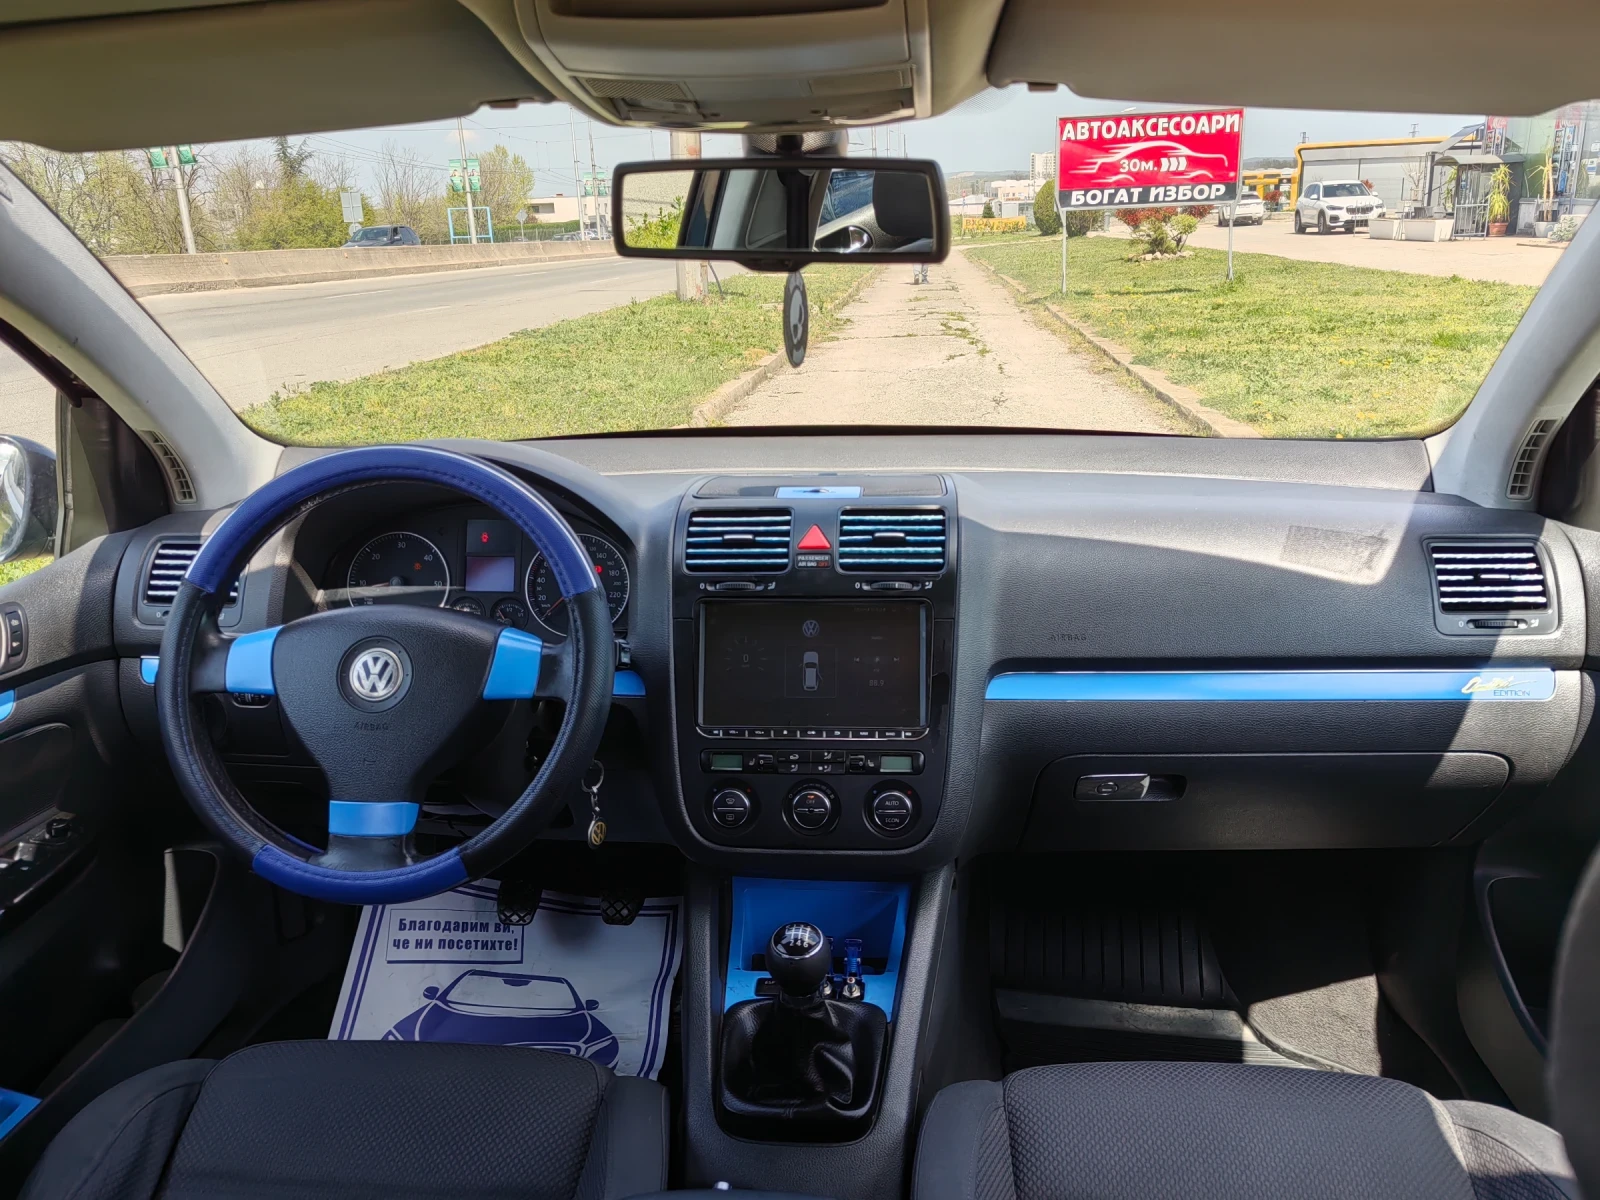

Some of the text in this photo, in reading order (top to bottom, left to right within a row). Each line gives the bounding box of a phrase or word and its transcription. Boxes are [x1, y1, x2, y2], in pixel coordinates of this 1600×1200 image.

[1062, 113, 1240, 141] АВТОАКСЕСОАРИ
[1119, 158, 1158, 173] 30м.
[1070, 184, 1226, 206] БОГАТ ИЗБОР
[1493, 689, 1531, 697] EDITION
[398, 918, 515, 934] Благодарим ви,
[392, 938, 518, 951] че ни посетихте!
